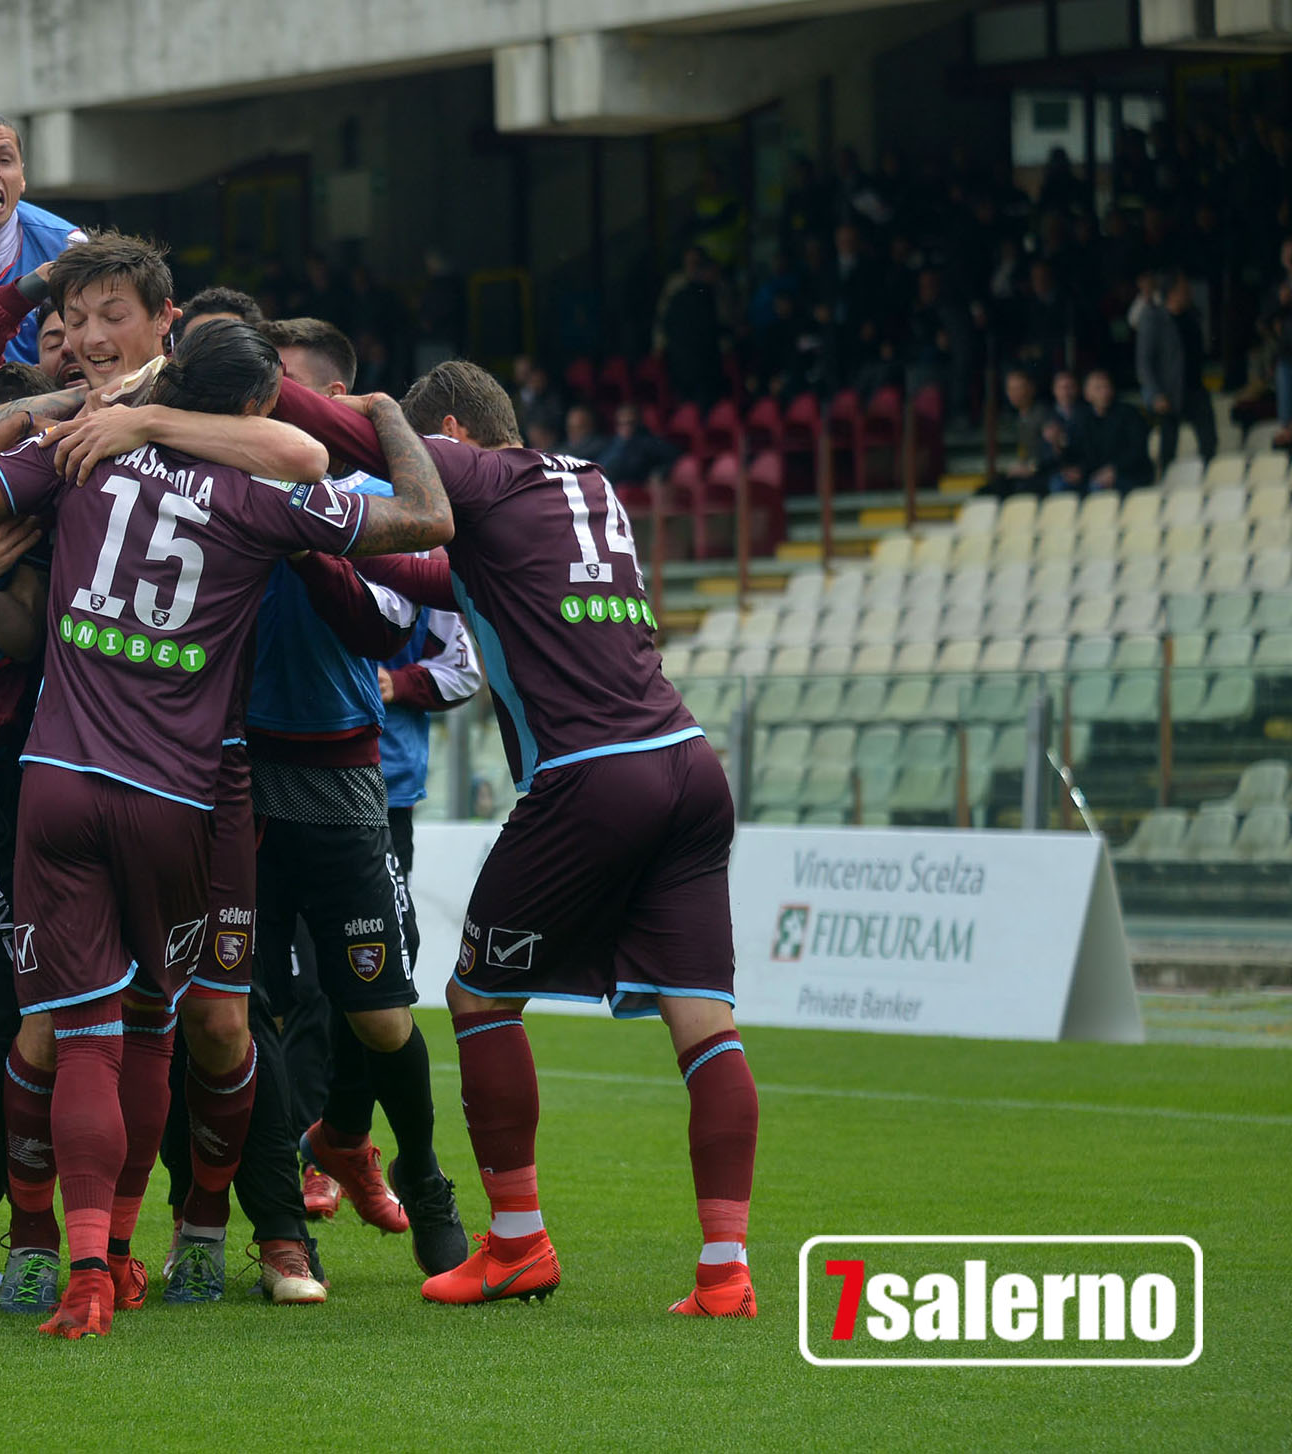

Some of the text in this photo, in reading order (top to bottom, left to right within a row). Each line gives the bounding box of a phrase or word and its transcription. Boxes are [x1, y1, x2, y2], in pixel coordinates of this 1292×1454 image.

[70, 474, 211, 631] 15
[542, 469, 645, 591] 14
[61, 616, 205, 671] UNIBET
[794, 850, 986, 896] Vincenzo Scelza
[811, 910, 976, 963] FIDEURAM
[798, 984, 923, 1021] Private Banker
